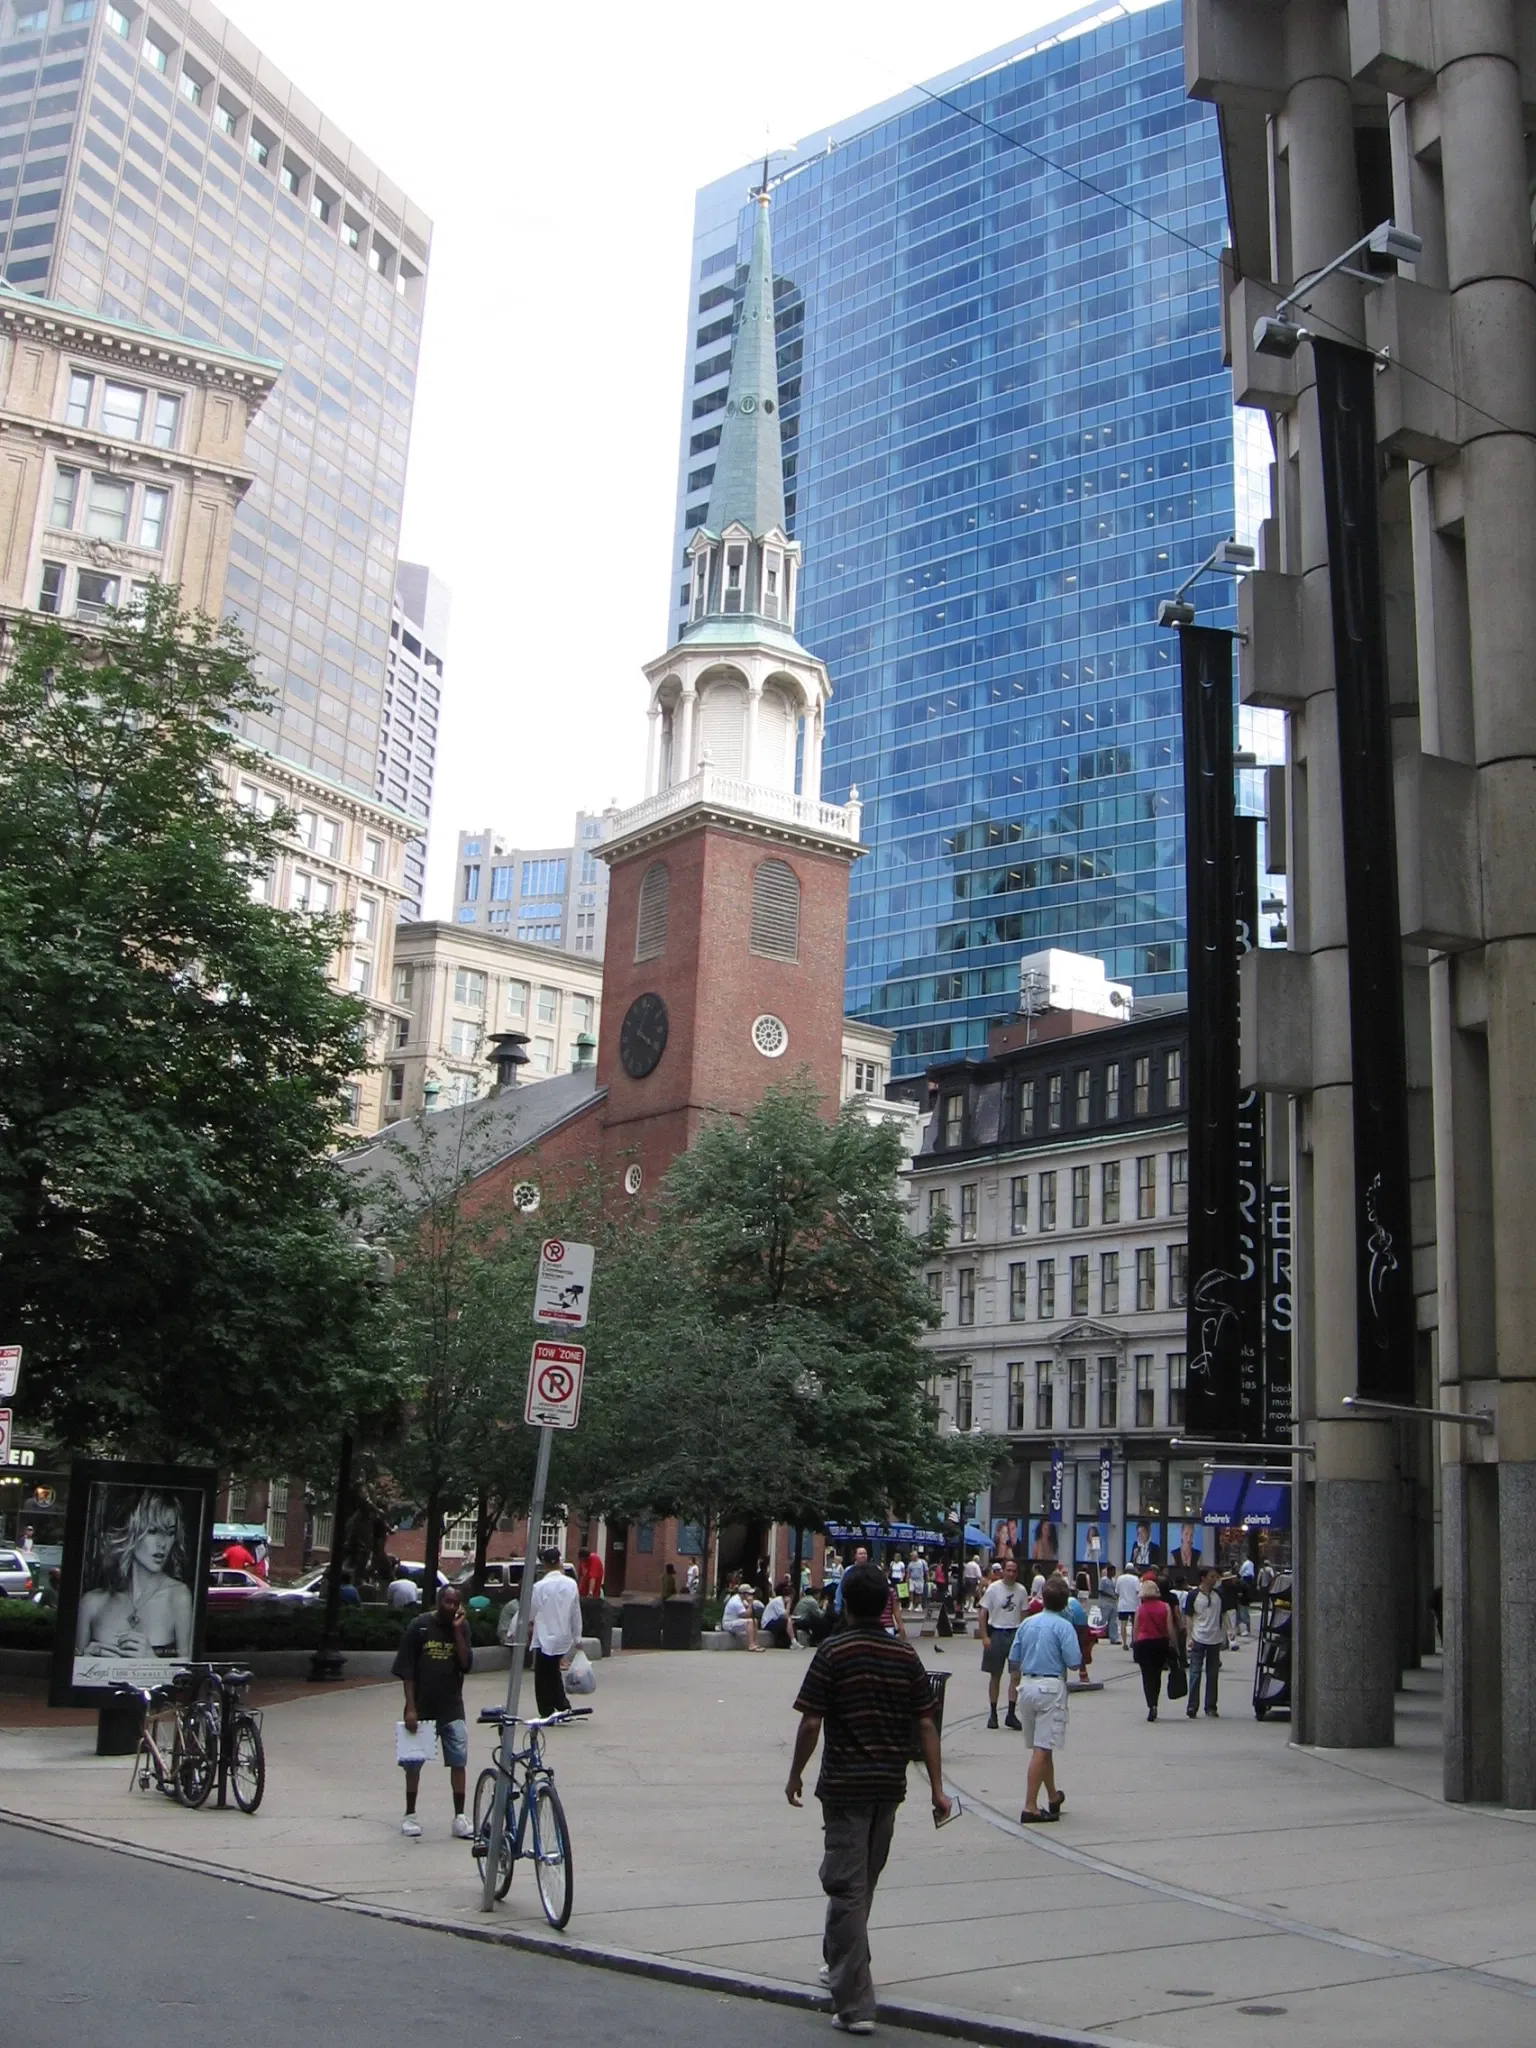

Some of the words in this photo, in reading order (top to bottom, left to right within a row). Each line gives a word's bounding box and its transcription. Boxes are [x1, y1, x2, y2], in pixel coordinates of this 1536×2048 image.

[537, 1347, 556, 1358] TOW
[558, 1349, 582, 1361] ZONE
[1052, 1459, 1064, 1511] claire's
[1099, 1459, 1110, 1511] claire's
[1204, 1513, 1230, 1524] claire's
[1244, 1513, 1271, 1525] claire's
